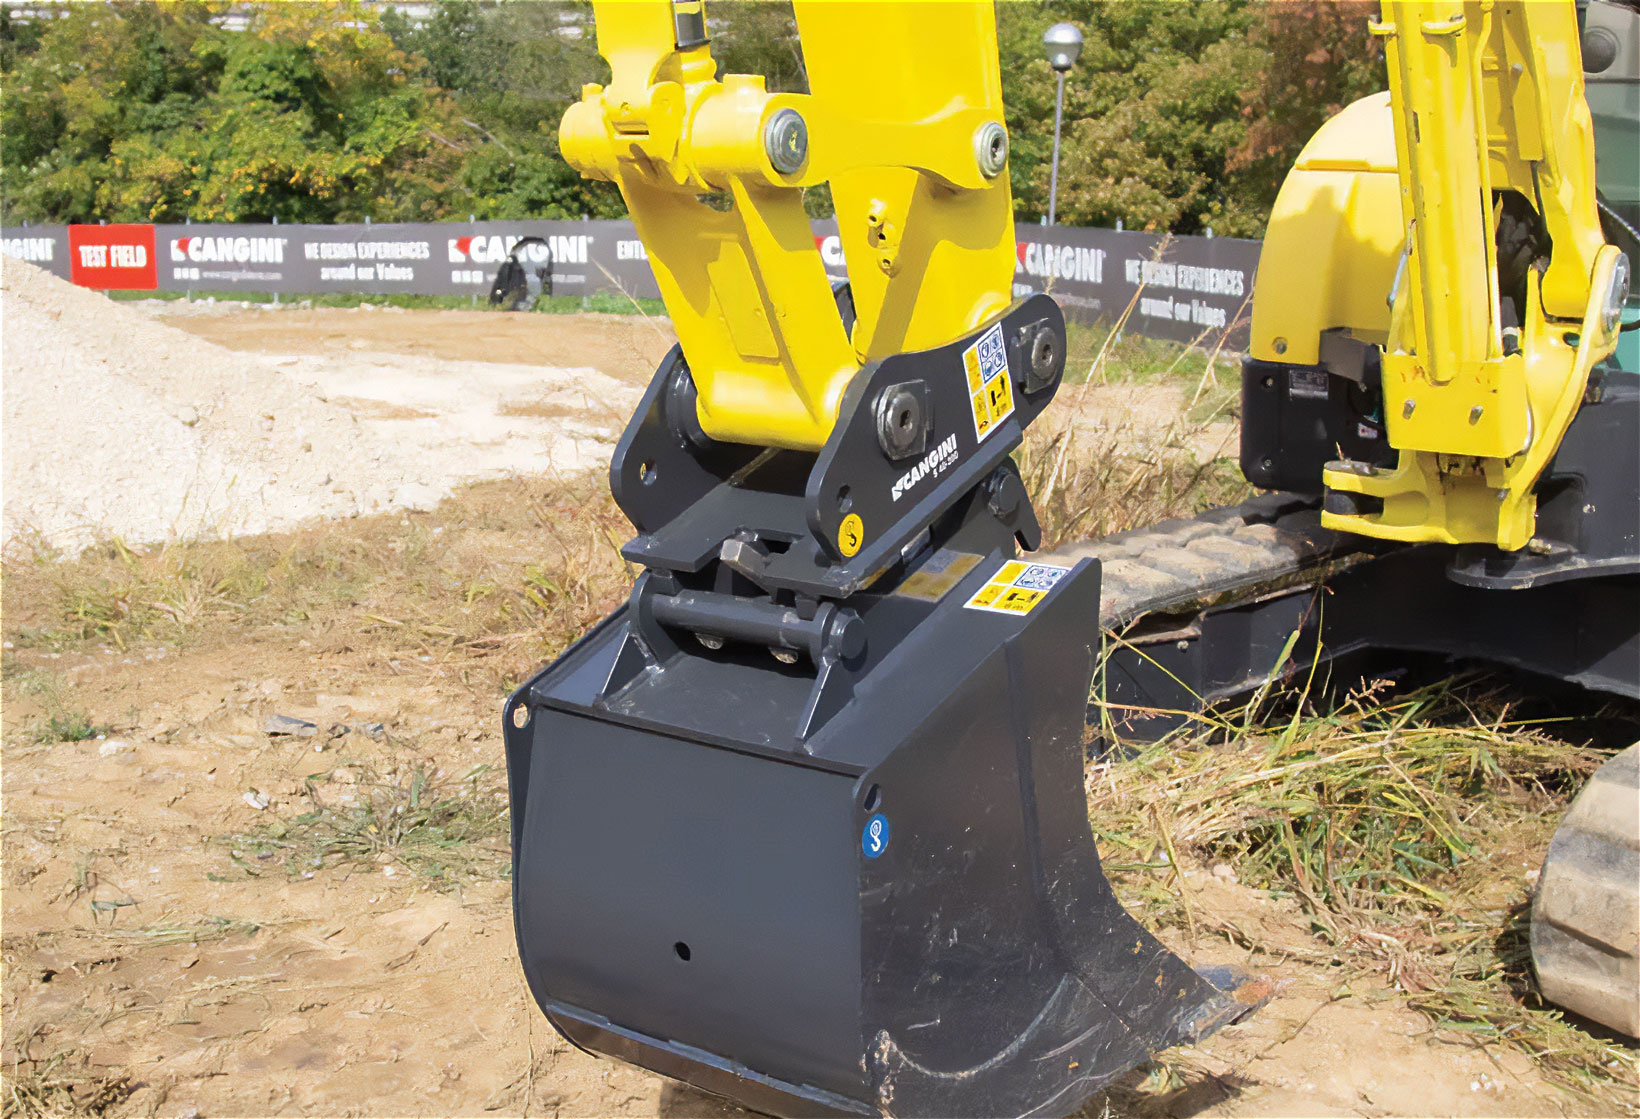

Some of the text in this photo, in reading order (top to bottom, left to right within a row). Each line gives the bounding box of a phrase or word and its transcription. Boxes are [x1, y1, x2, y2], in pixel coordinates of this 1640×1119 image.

[78, 245, 147, 268] TEST FIELD
[188, 236, 284, 263] CANGINI
[1025, 242, 1103, 284] CANGINI
[903, 433, 957, 491] CANGINI
